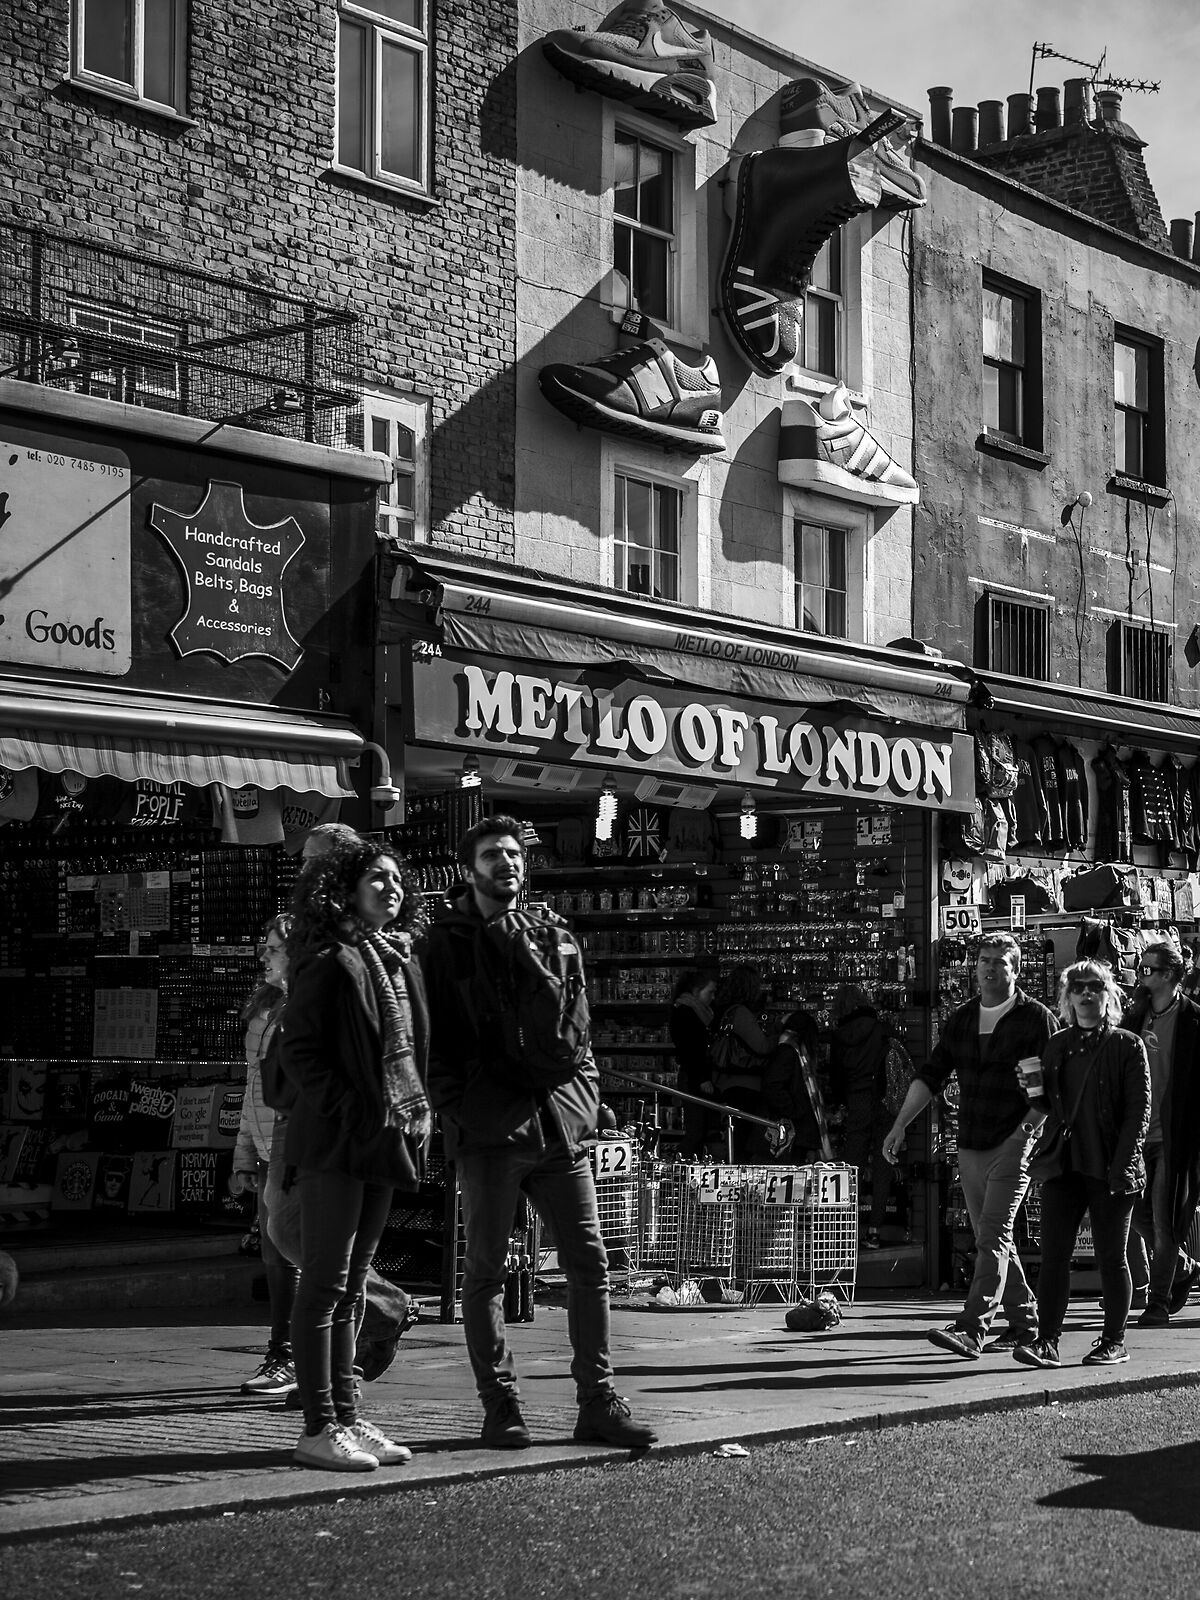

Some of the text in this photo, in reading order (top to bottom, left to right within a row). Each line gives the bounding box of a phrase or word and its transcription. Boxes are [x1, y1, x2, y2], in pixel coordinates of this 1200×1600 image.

[27, 450, 125, 478] tel: 020 7485 9195
[185, 525, 282, 555] Handcrafted
[205, 551, 263, 574] Sandals
[228, 598, 239, 613] &
[464, 594, 492, 615] 244
[25, 608, 116, 651] Goods
[196, 615, 272, 637] Accessories
[420, 641, 443, 657] 244
[673, 632, 800, 671] METLO OF LONDON
[934, 682, 953, 697] 244
[463, 664, 669, 756] METLO
[680, 702, 750, 766] OF
[759, 715, 954, 797] LONDON
[93, 1089, 130, 1105] COCAIN
[130, 1080, 167, 1099] twenty
[128, 1101, 159, 1117] pilots
[141, 1095, 160, 1107] one
[93, 1111, 125, 1123] Cavia
[180, 1106, 208, 1123] Gogle
[700, 1168, 720, 1190] £1
[765, 1174, 794, 1204] £1
[821, 1173, 841, 1203] £1
[716, 1190, 723, 1202] 6
[728, 1187, 740, 1202] £5
